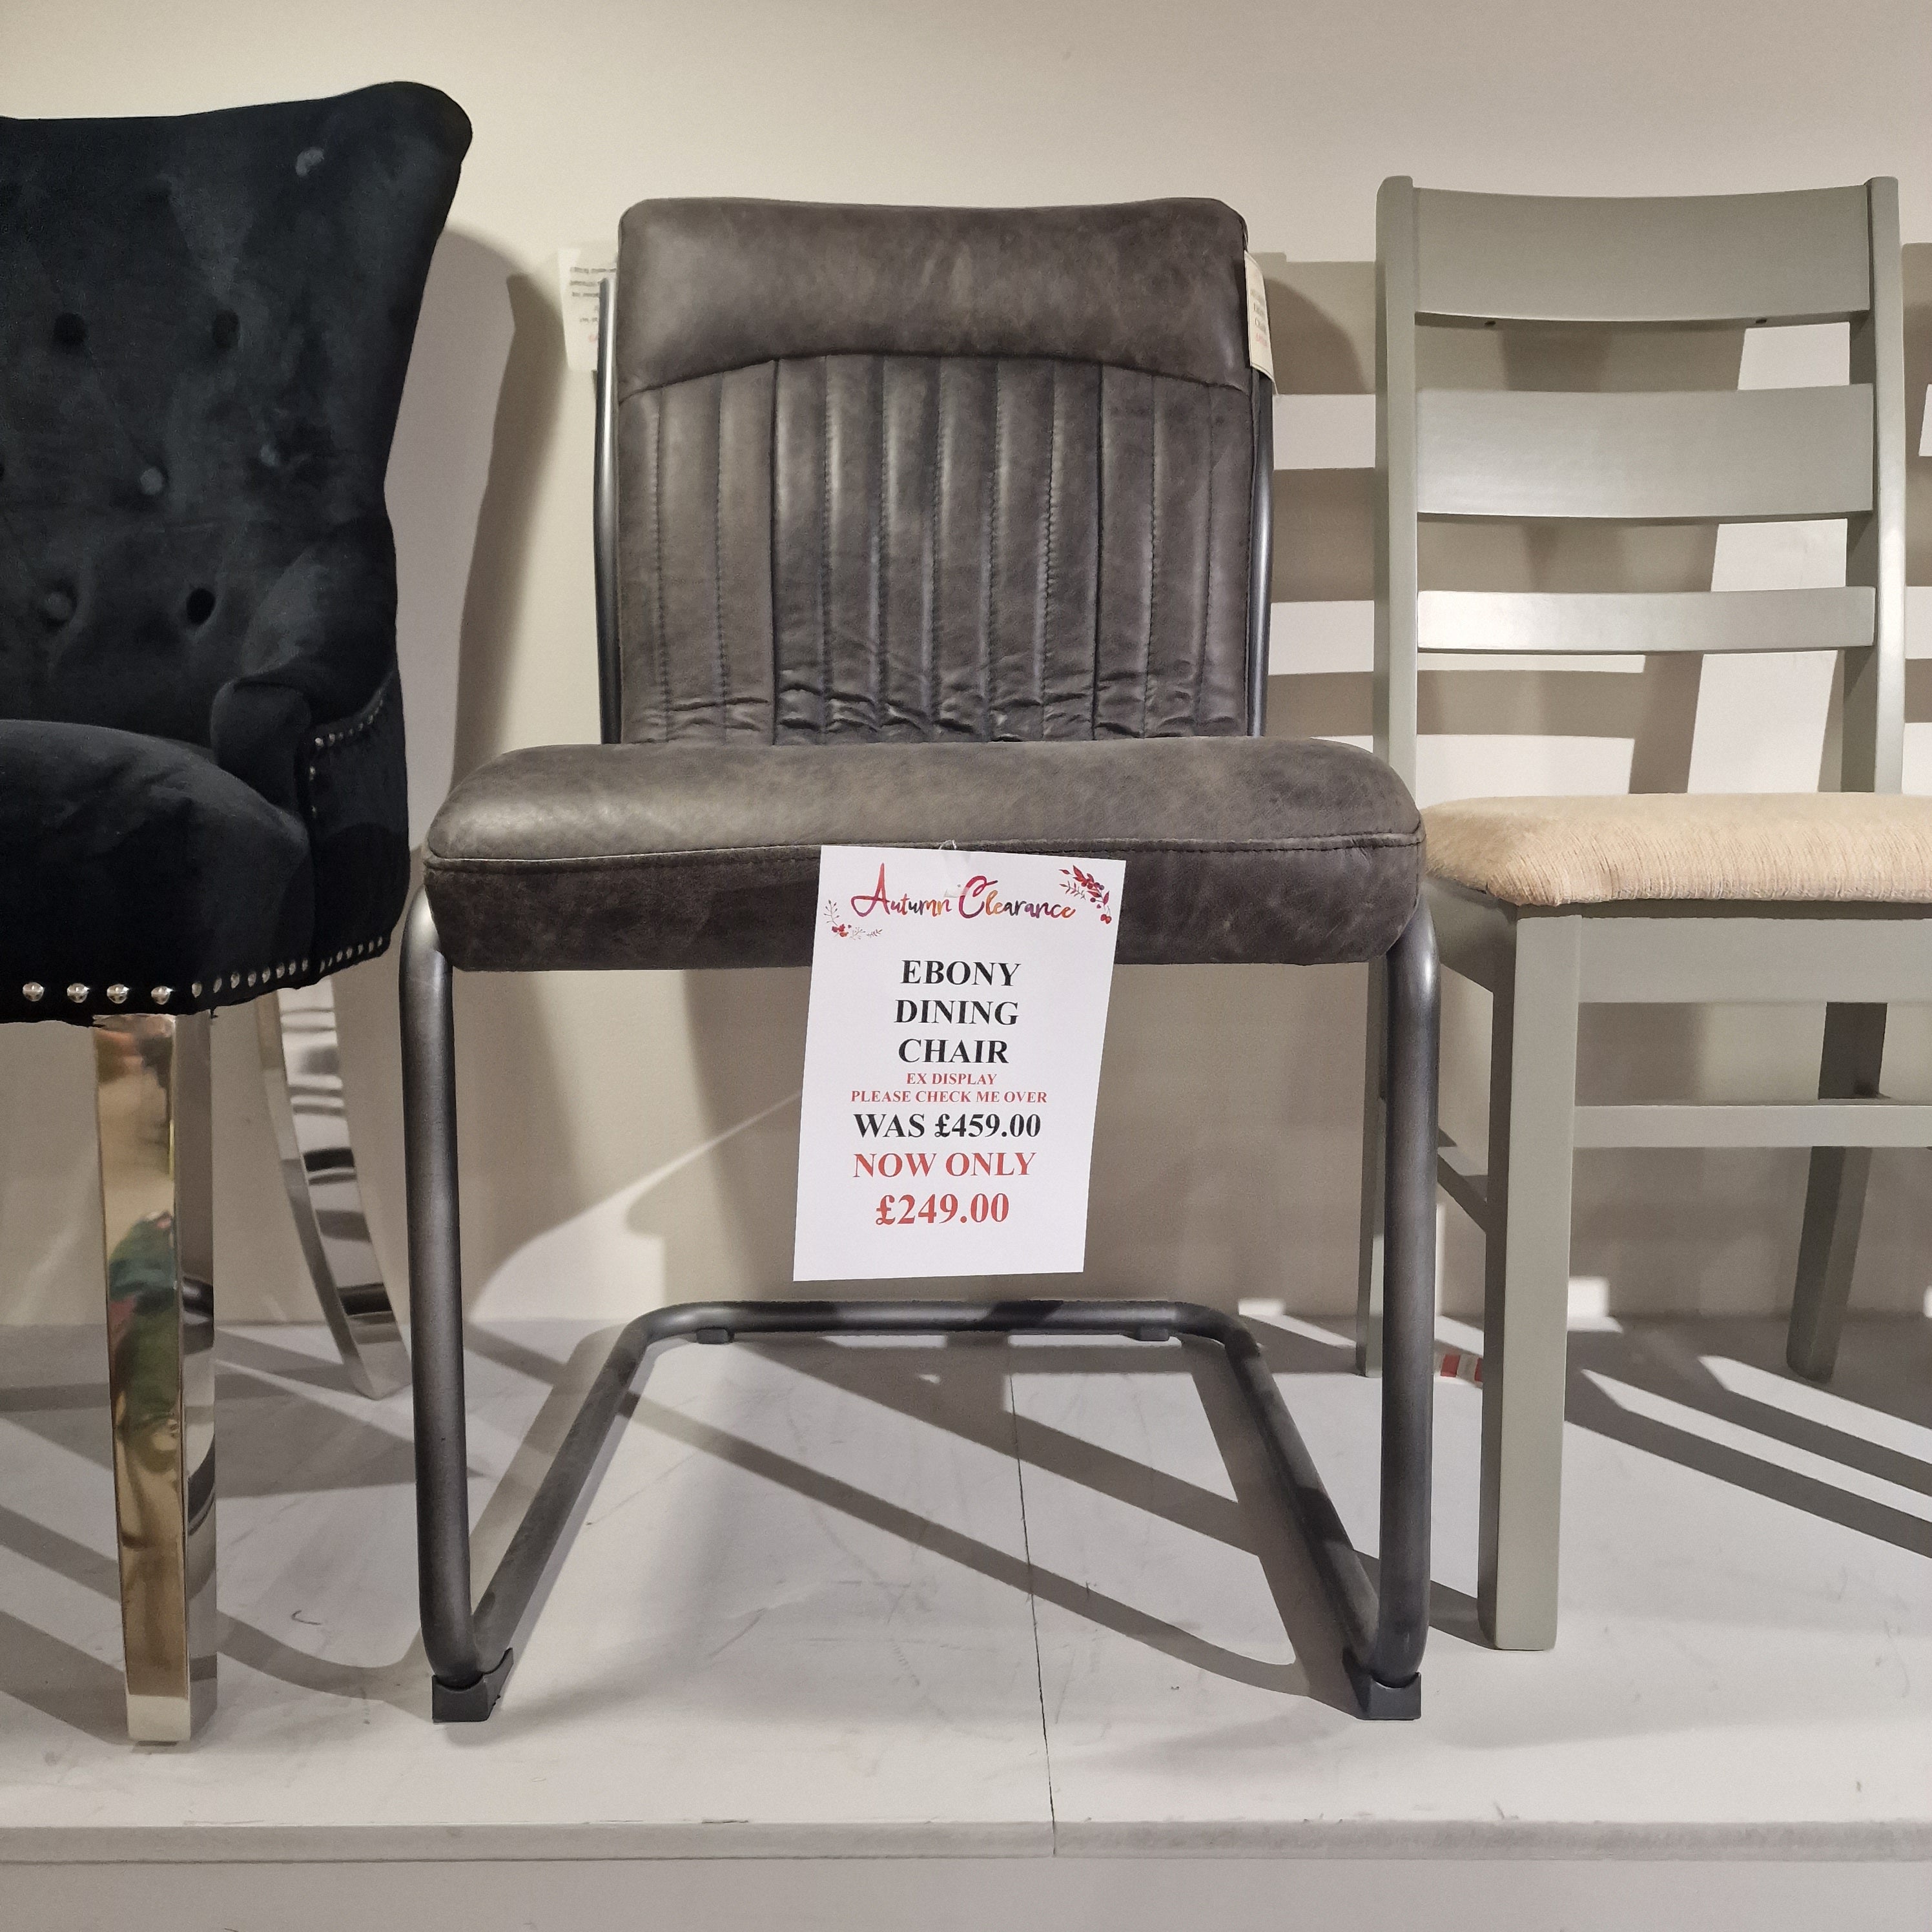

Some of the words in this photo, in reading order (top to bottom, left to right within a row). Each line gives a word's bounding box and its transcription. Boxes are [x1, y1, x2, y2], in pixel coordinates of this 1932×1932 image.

[850, 863, 951, 918] Autumn
[958, 875, 1076, 919] Clearance
[900, 960, 1022, 987] EBONY
[894, 1000, 1019, 1025] DINING
[898, 1038, 1009, 1064] CHAIR
[907, 1073, 927, 1084] EX
[932, 1073, 997, 1085] DISPLAY
[851, 1091, 911, 1102] PLEASE
[915, 1091, 971, 1102] CHECK
[976, 1091, 1000, 1102] ME
[1003, 1091, 1047, 1103] OVER
[853, 1113, 925, 1138] WAS
[934, 1113, 1041, 1138] £459.00
[853, 1153, 937, 1178] NOW
[945, 1152, 1036, 1177] ONLY
[876, 1193, 1009, 1226] £249.00
